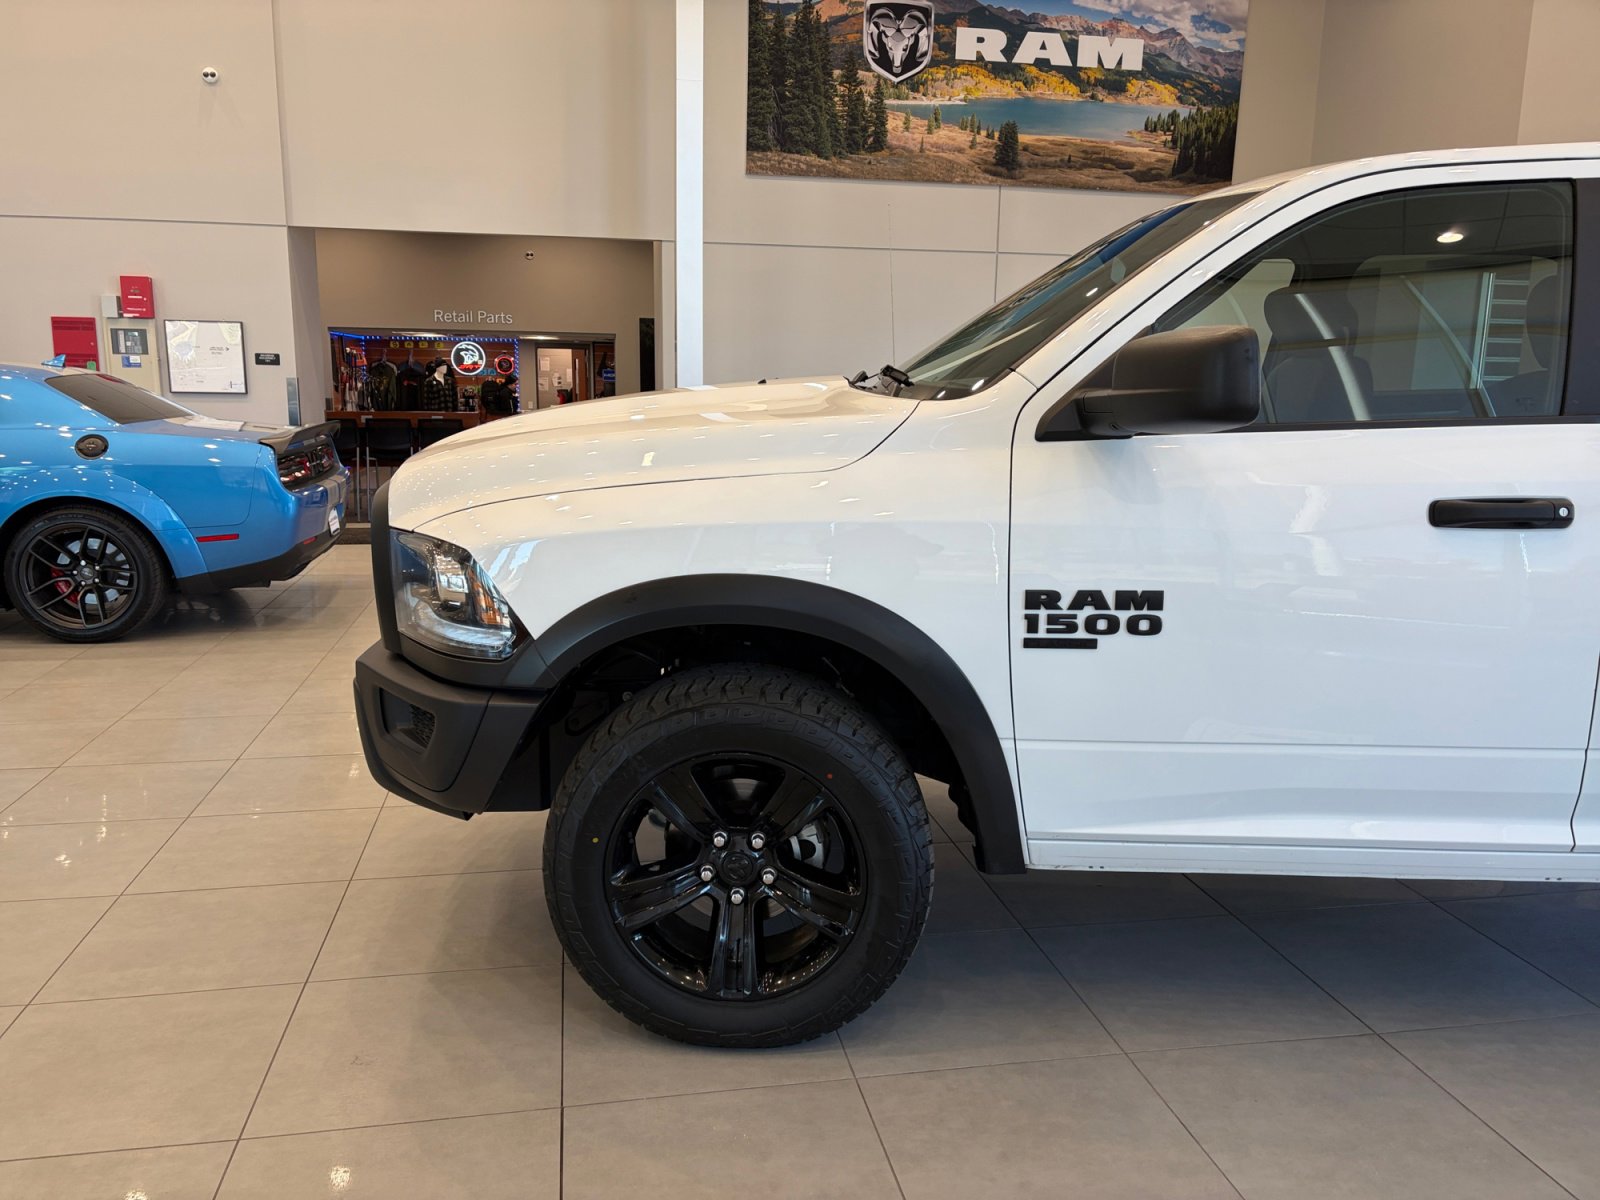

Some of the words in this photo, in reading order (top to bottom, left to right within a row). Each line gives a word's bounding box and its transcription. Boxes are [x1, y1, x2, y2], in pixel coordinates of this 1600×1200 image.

[955, 26, 1145, 72] RAM
[434, 309, 473, 324] Retail
[477, 310, 513, 325] Parts
[1024, 589, 1165, 611] RAM
[1024, 613, 1163, 636] 1500
